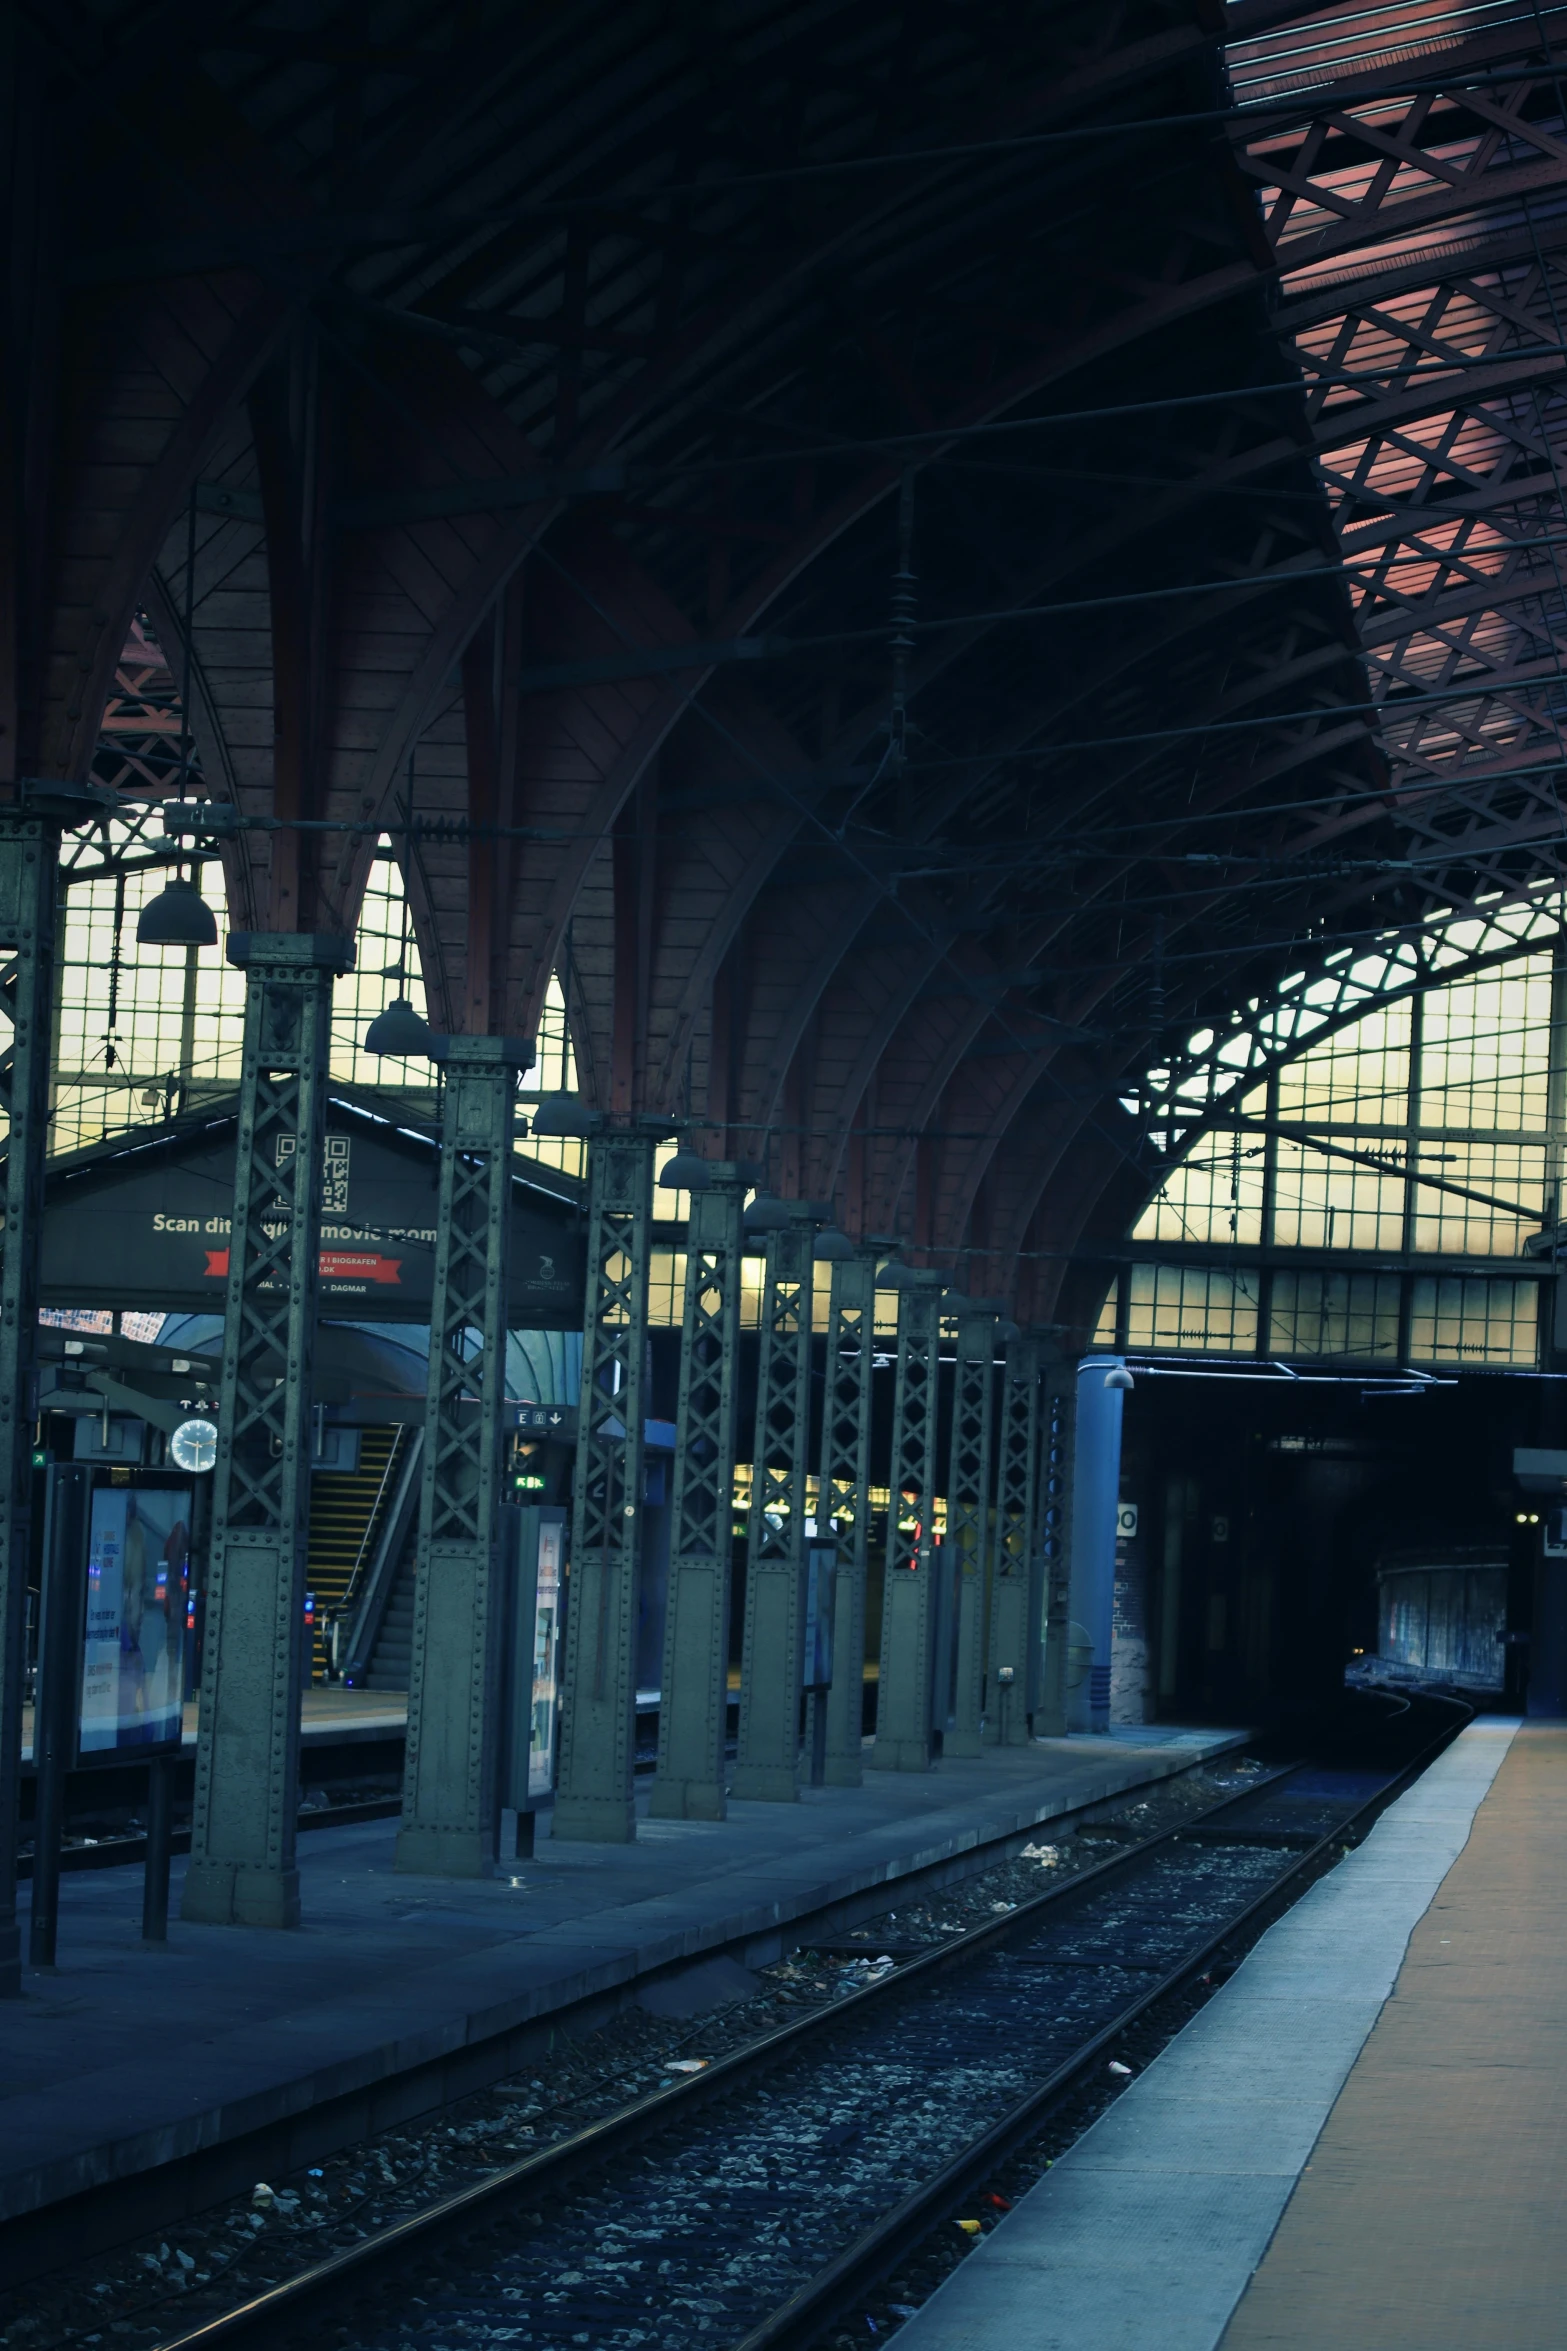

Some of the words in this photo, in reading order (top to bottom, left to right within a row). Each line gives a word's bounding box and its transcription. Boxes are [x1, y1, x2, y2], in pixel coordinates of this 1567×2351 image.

[153, 1213, 200, 1233] Scan
[205, 1216, 232, 1234] dit
[320, 1223, 382, 1241] movie
[332, 1257, 377, 1266] BIOGRAFEN
[330, 1284, 367, 1293] DAGMAR
[519, 1413, 528, 1424] E
